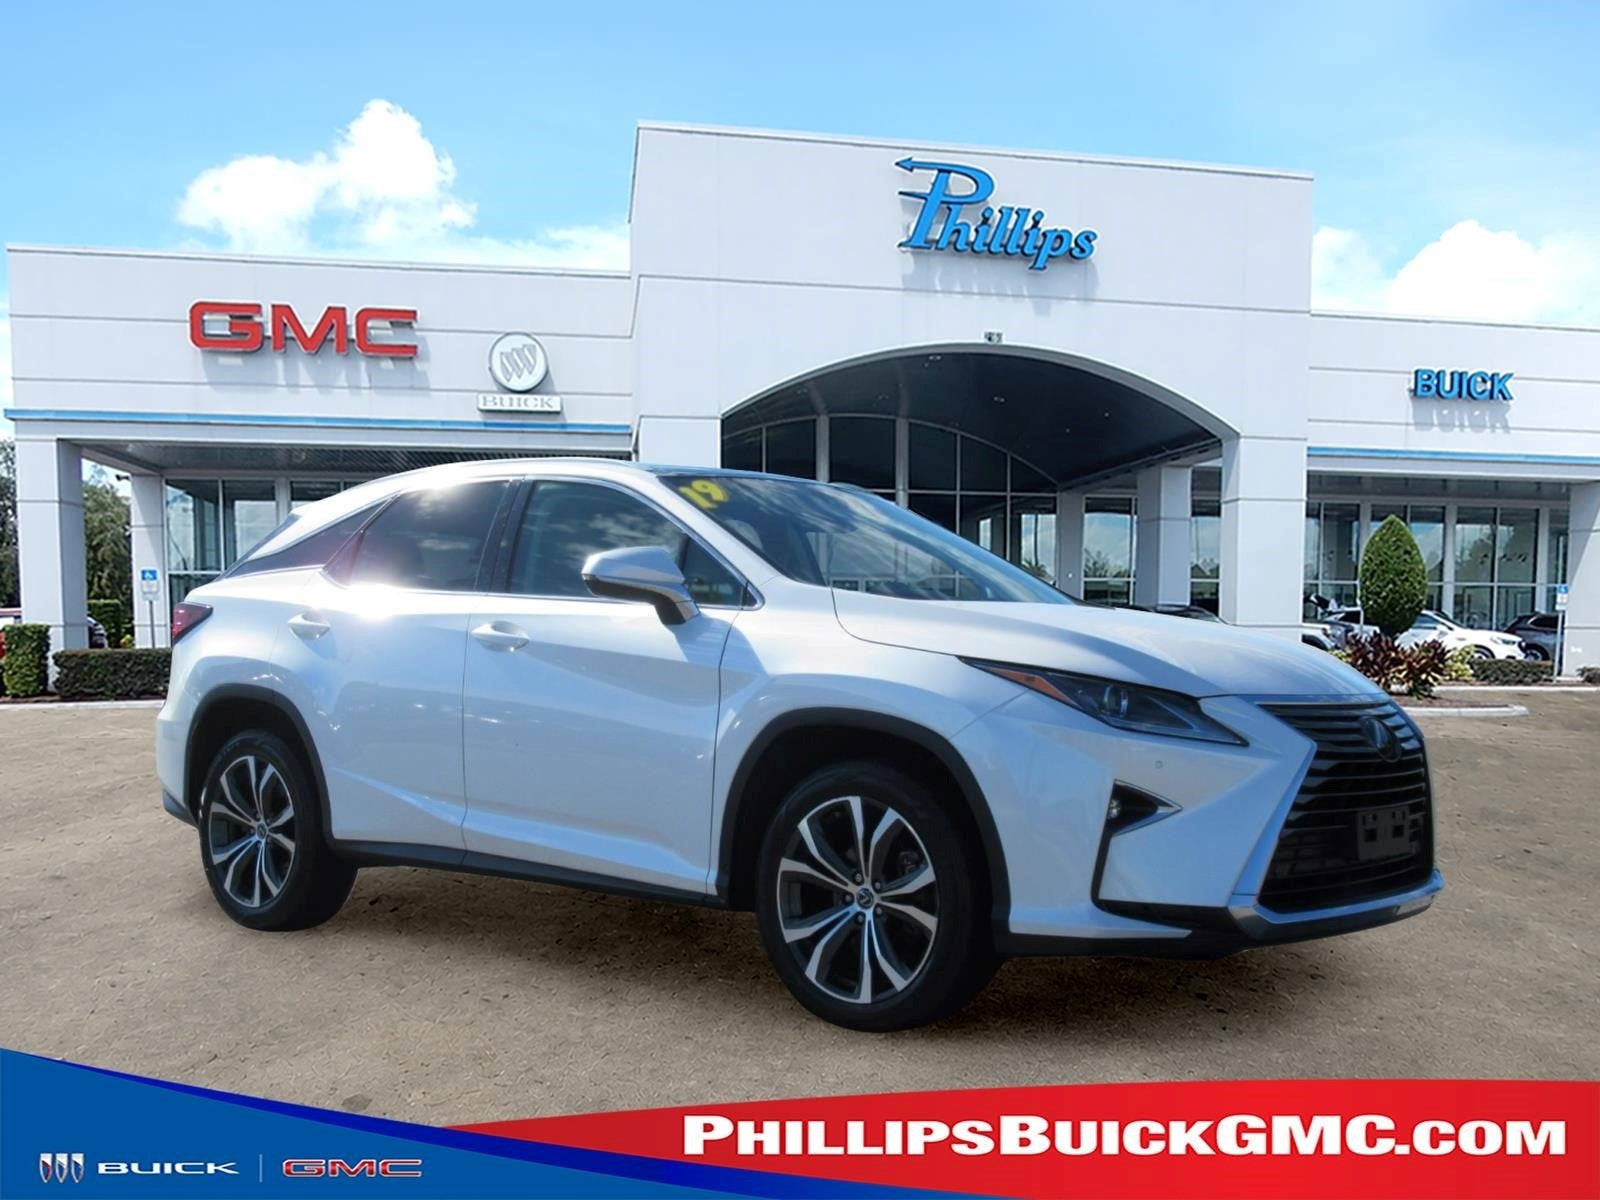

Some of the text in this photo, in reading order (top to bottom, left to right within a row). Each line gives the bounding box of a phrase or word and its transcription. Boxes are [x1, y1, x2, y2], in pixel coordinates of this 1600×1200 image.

[895, 157, 1098, 270] Phillips
[189, 300, 418, 358] GMC
[1414, 368, 1514, 401] BUICK
[482, 395, 554, 409] BUICK
[678, 480, 728, 509] 19
